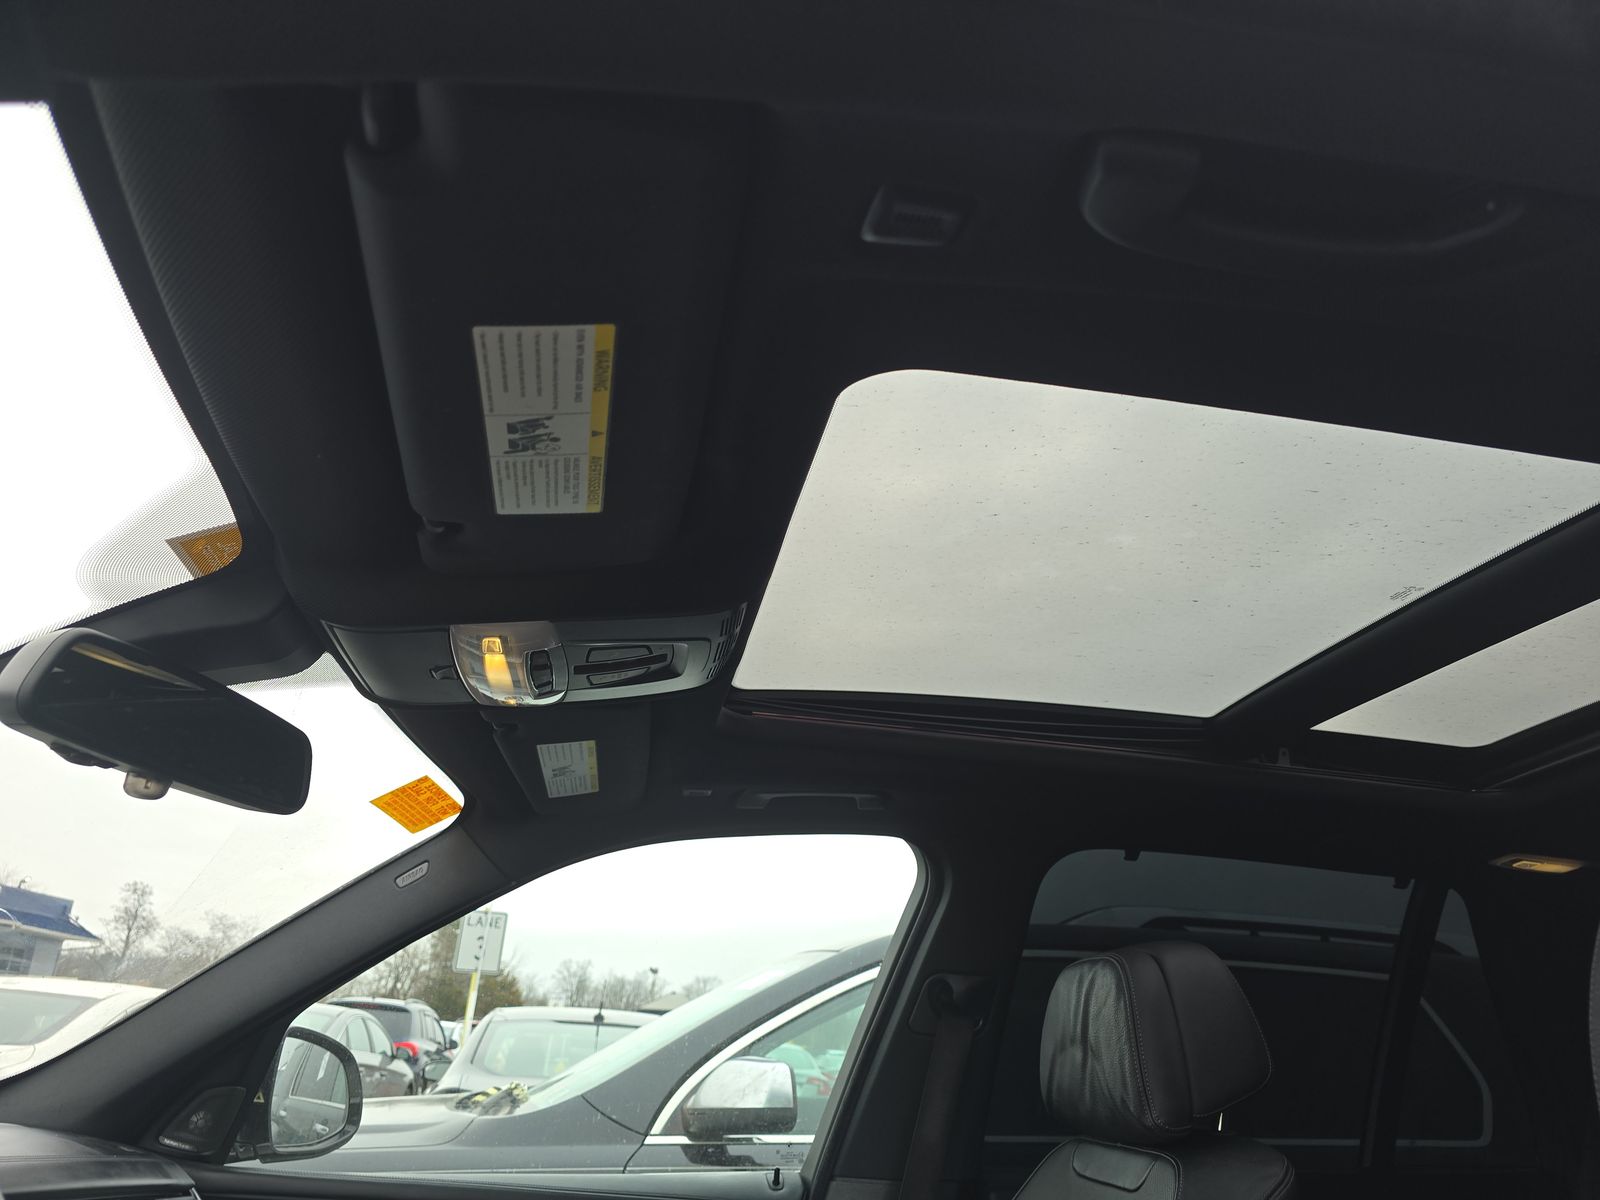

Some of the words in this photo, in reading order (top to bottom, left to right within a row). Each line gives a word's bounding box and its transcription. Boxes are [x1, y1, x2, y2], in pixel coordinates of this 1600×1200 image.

[593, 350, 610, 392] WARNING
[588, 456, 602, 505] AVERTISSEMENT
[466, 915, 502, 928] LANE
